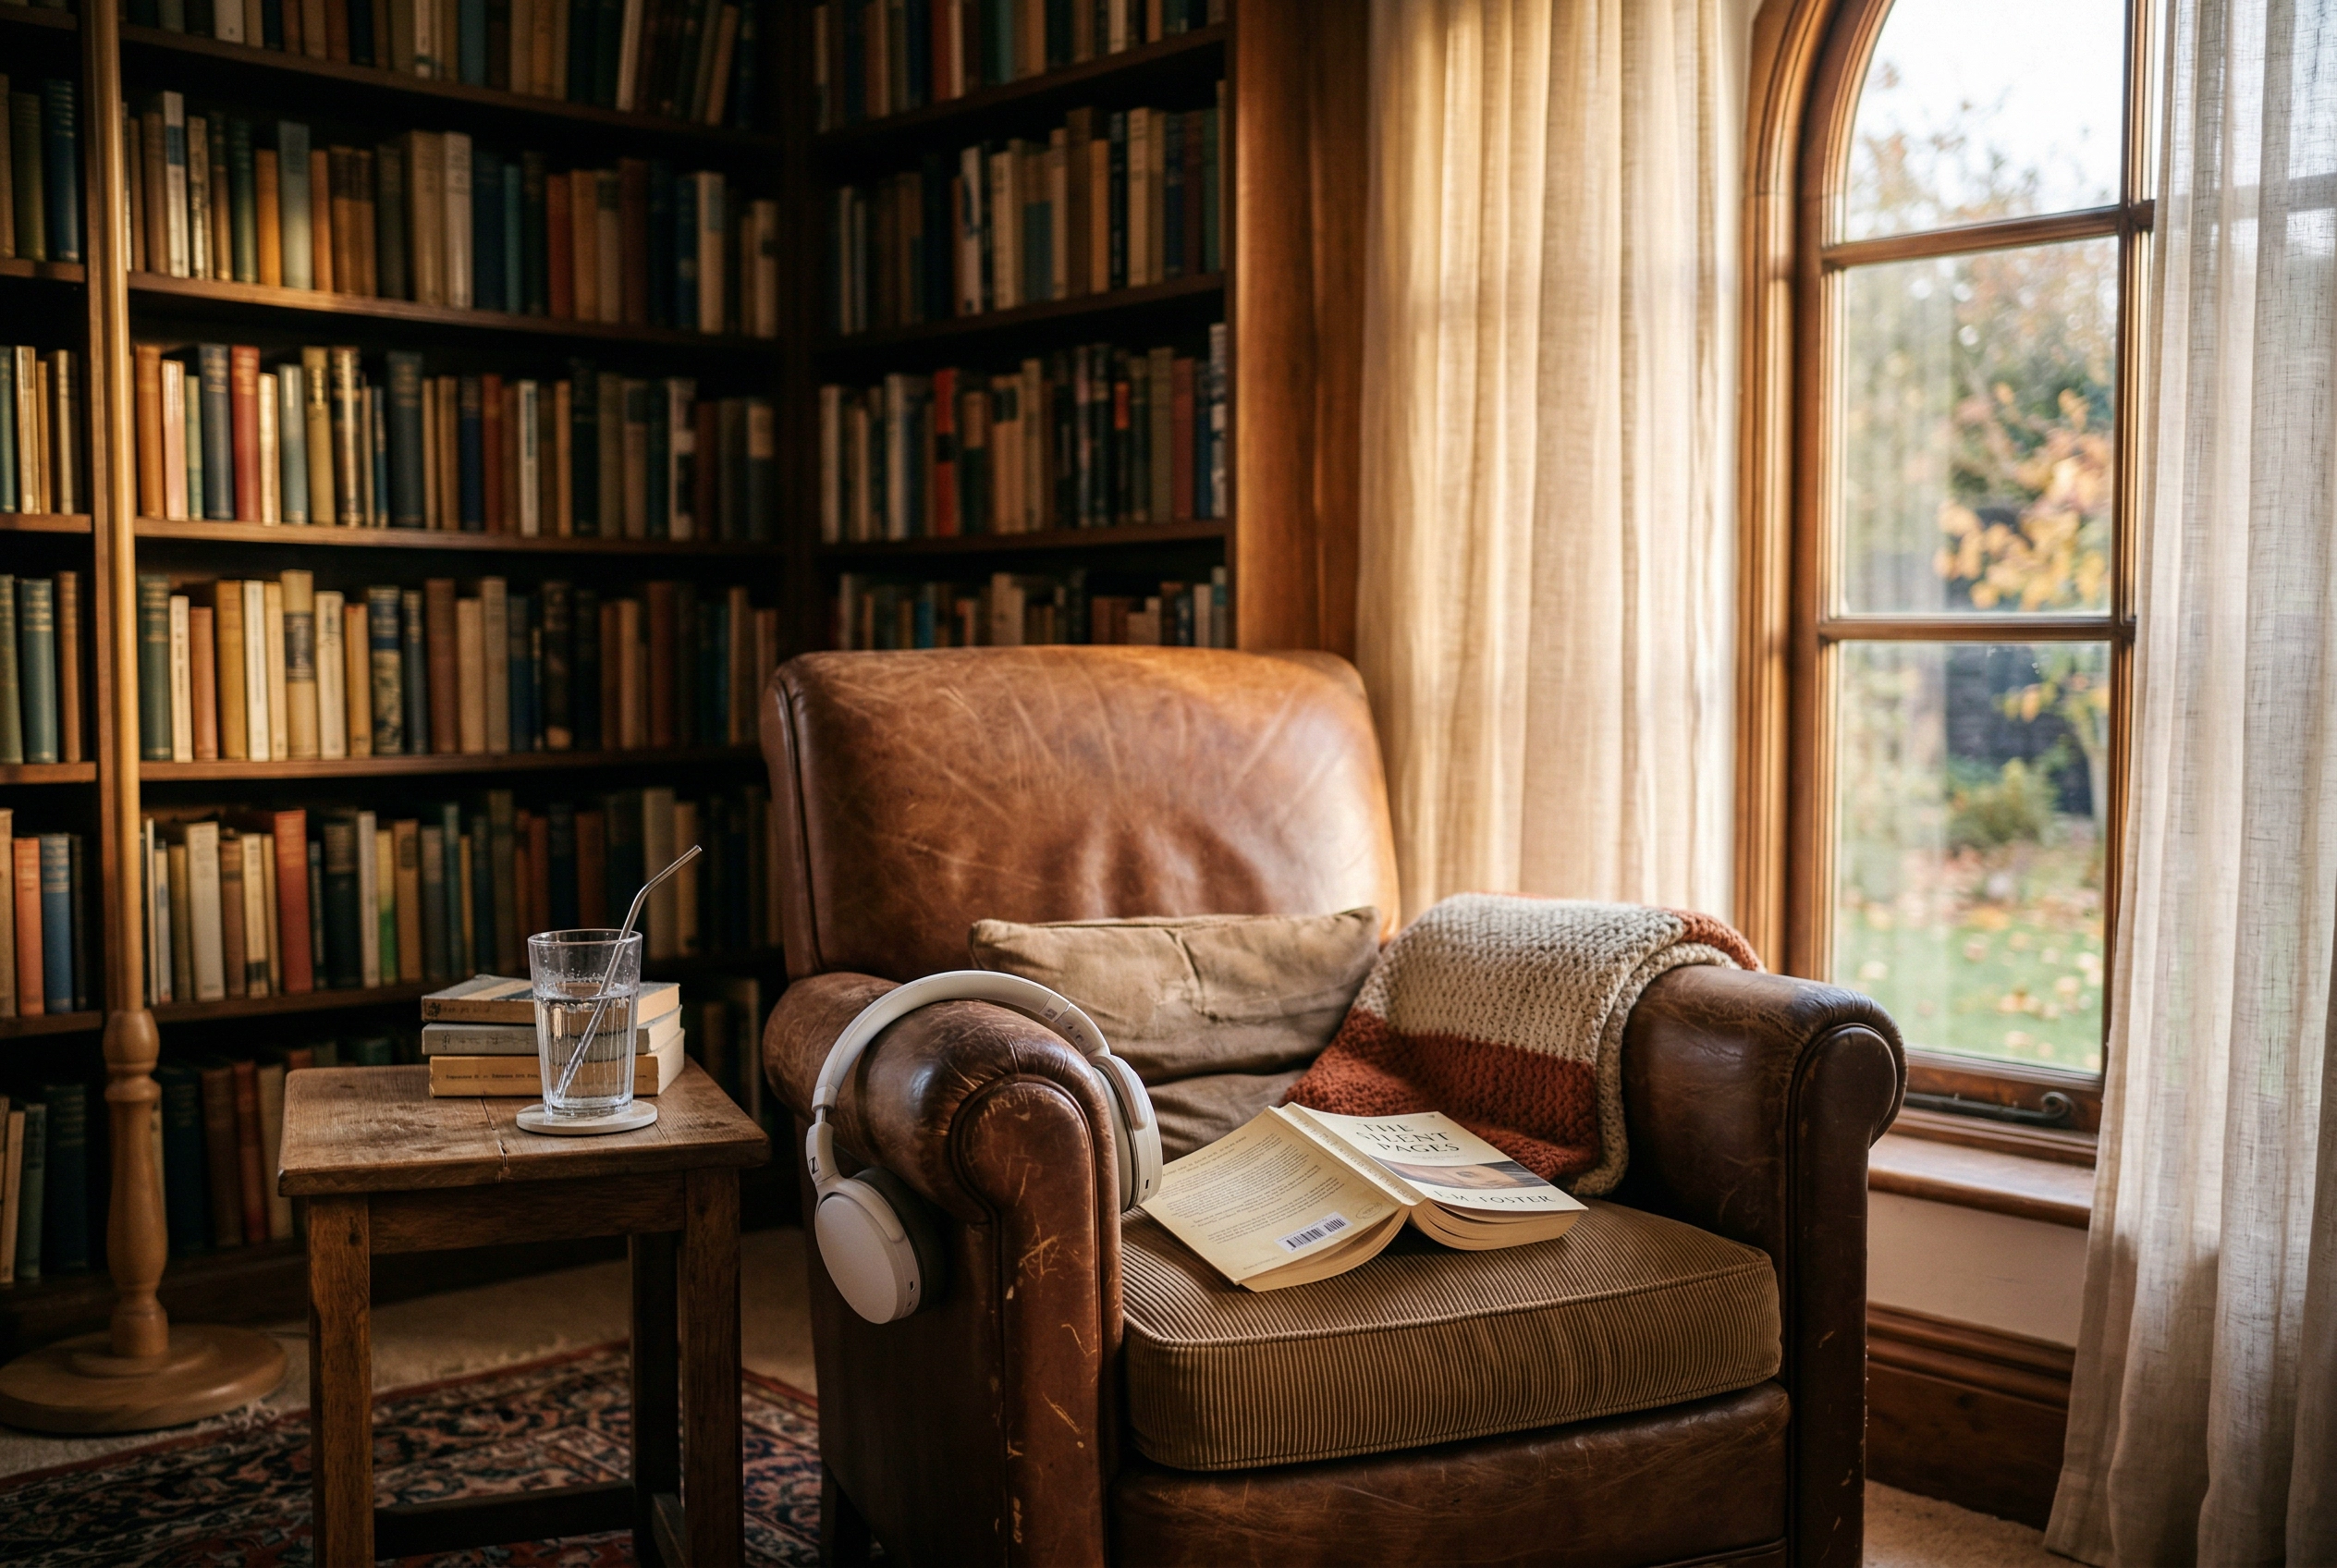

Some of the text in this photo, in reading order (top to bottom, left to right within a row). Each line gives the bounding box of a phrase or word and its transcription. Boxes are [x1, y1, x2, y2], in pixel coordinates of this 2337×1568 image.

[1356, 1122, 1414, 1133] THE
[1355, 1131, 1450, 1143] SILENT
[1377, 1143, 1460, 1153] PAGES
[1478, 1195, 1557, 1204] FOSTER
